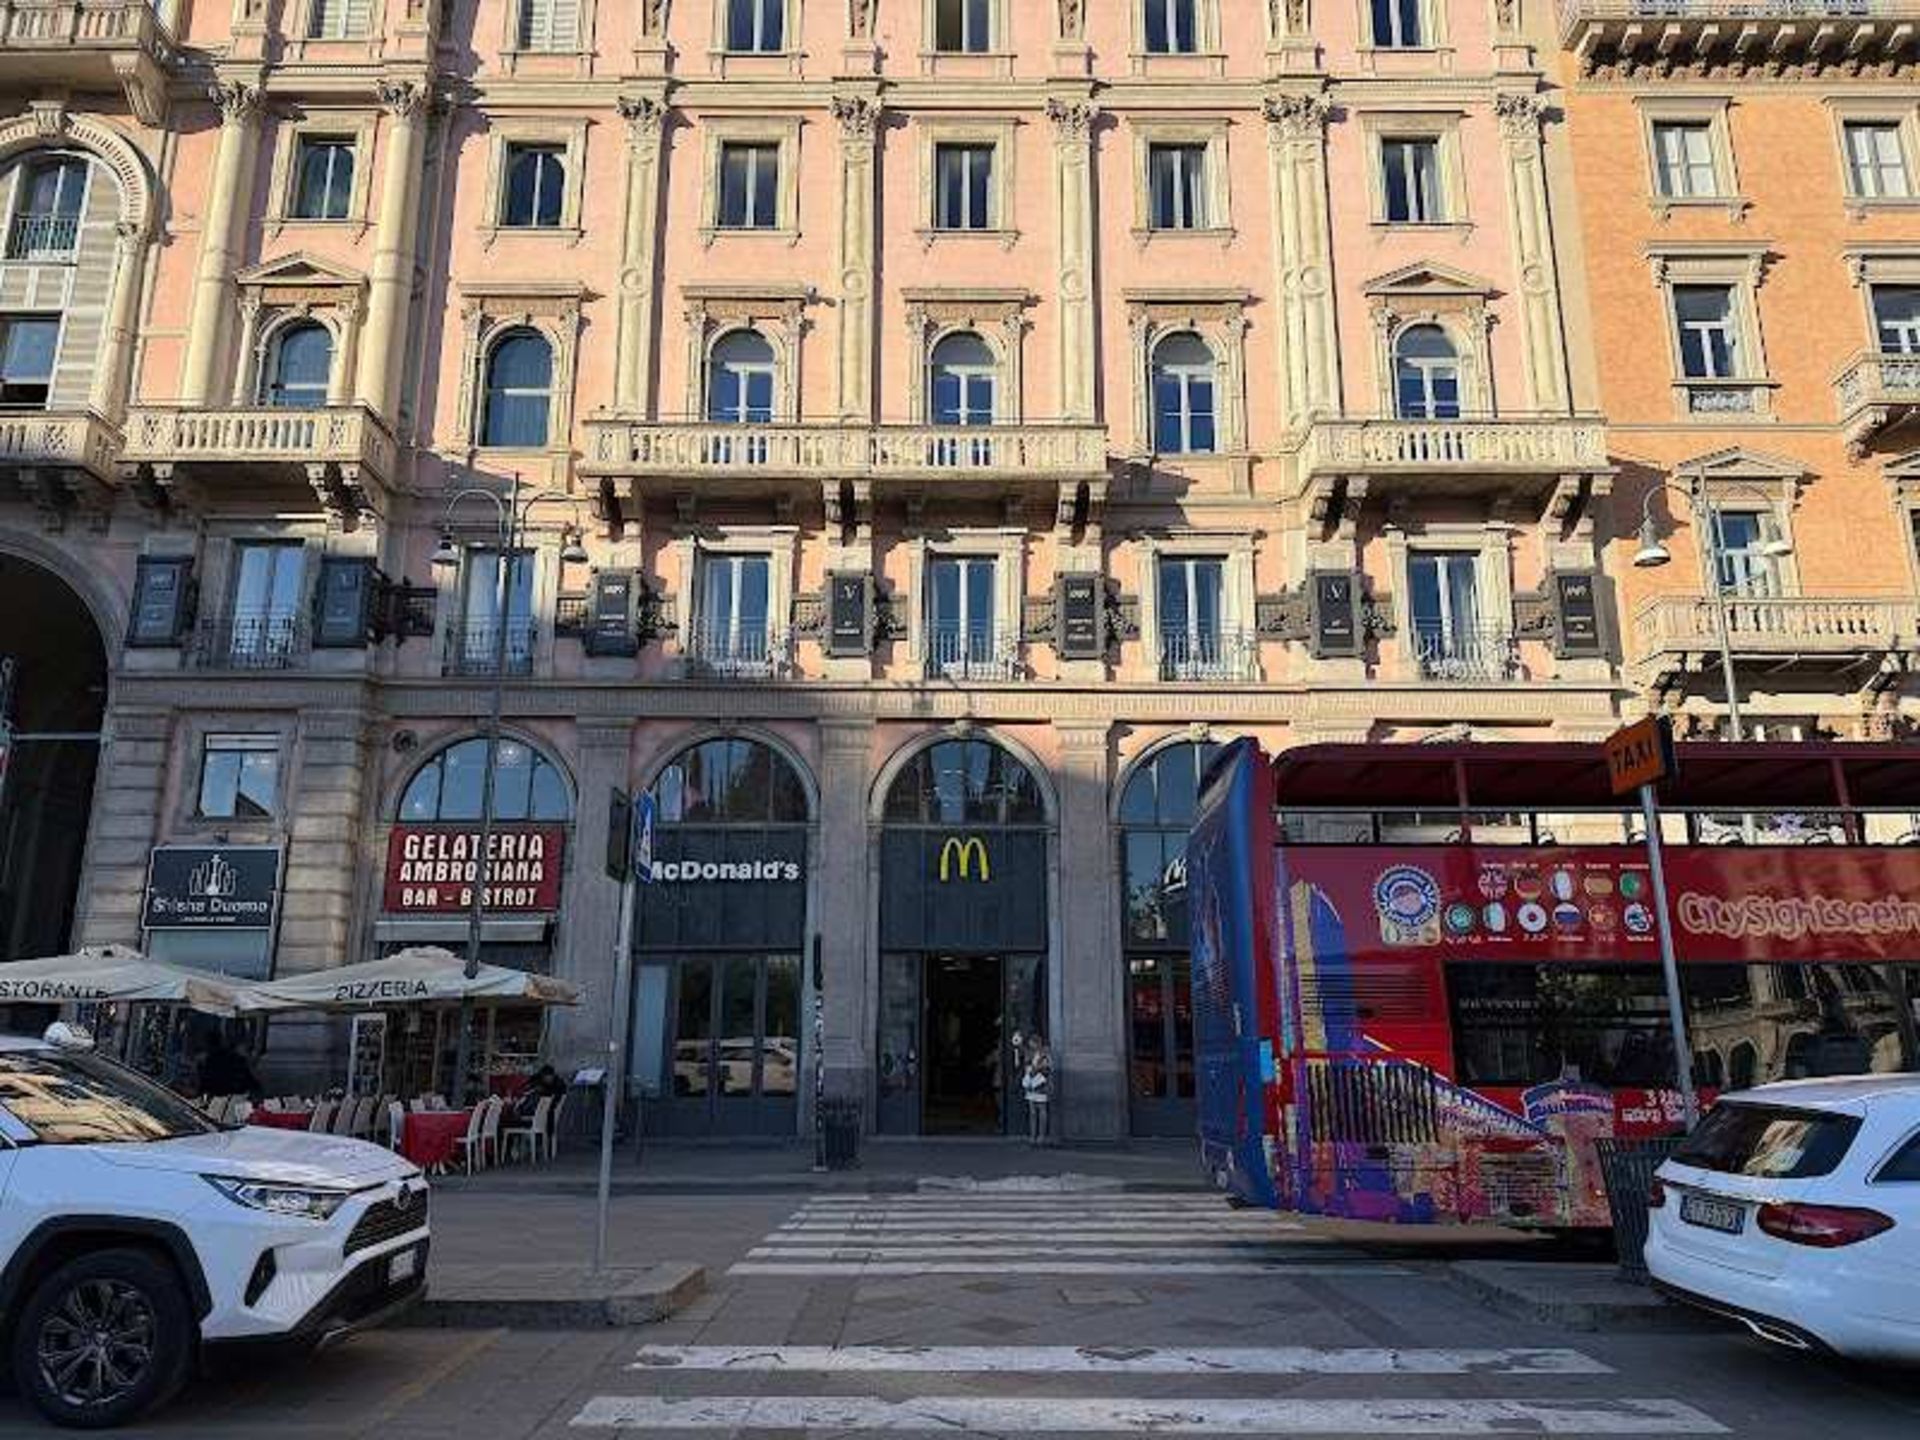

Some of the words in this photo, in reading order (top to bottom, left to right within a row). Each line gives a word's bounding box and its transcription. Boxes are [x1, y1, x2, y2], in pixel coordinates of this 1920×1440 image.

[1612, 737, 1653, 776] TAXI
[404, 834, 544, 860] GELATERIA
[650, 860, 800, 881] McDonald's
[210, 897, 268, 913] Duomo
[402, 887, 438, 907] BAR
[460, 887, 537, 907] BSTROT
[335, 980, 428, 1001] PIZZERIA
